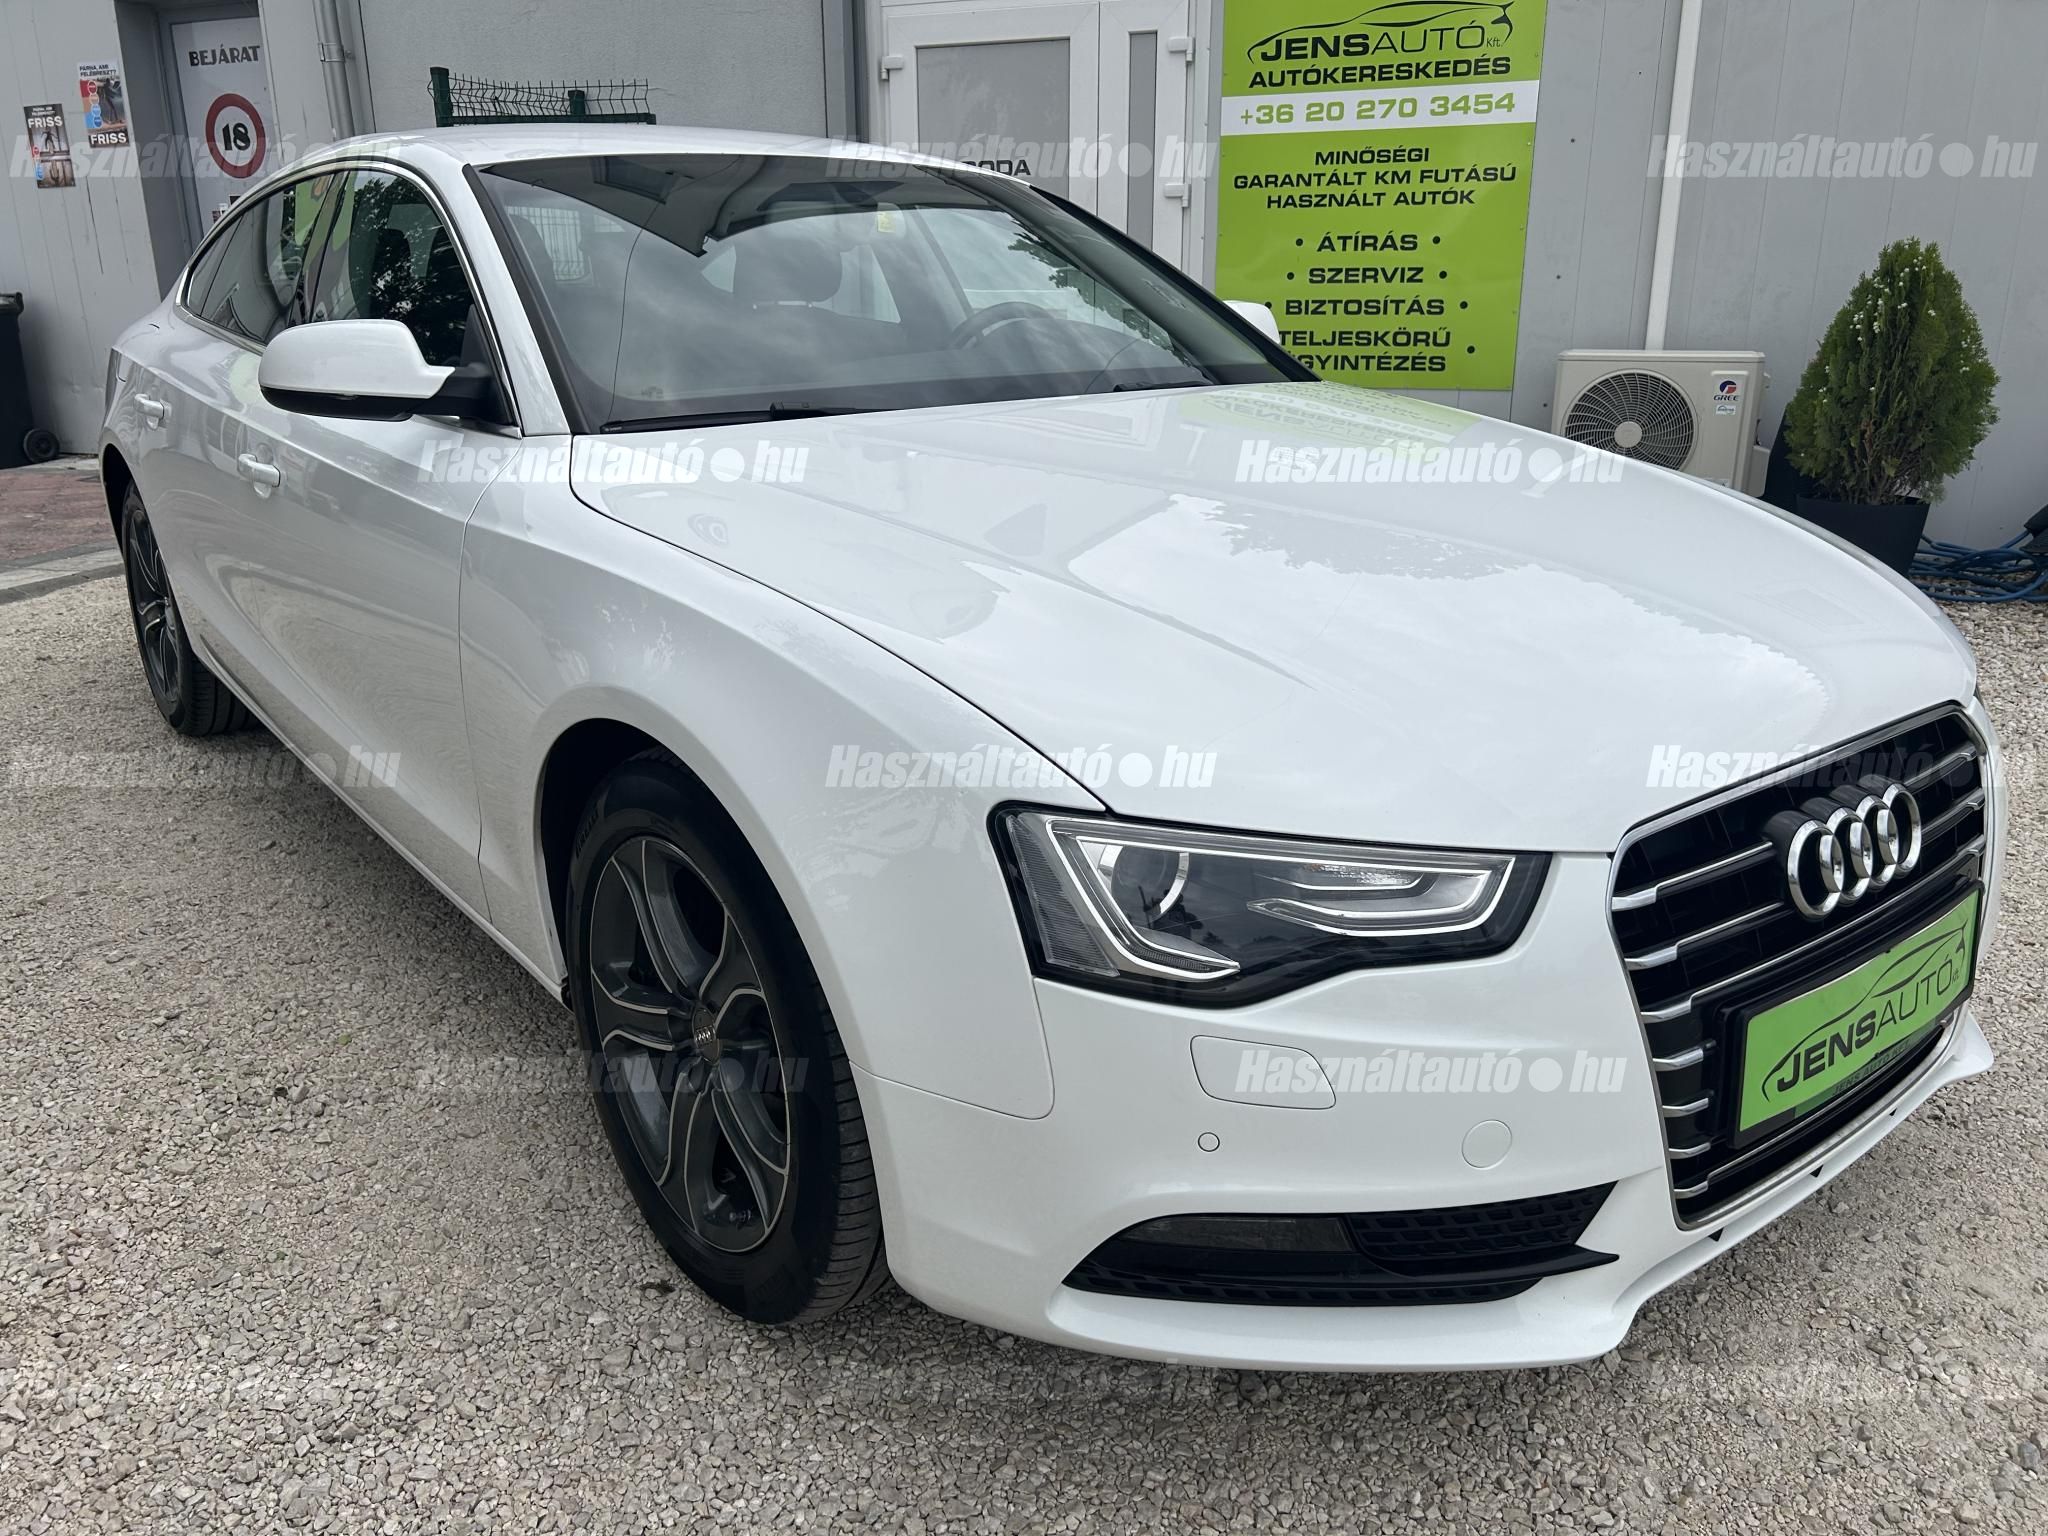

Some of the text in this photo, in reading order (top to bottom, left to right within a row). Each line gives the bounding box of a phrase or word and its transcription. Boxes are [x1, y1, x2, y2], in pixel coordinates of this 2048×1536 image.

[1261, 20, 1486, 62] JENSAUTÓ
[189, 45, 261, 67] BEJÁRAT
[1248, 53, 1512, 89] AUTÓKERESKEDÉS
[1240, 92, 1516, 125] +36 20 270 3454
[28, 115, 63, 129] FRISS
[90, 132, 127, 145] FRISS
[222, 122, 251, 152] 18
[1315, 145, 1430, 166] MINŐSÉGI
[962, 159, 1031, 176] ODA
[1233, 164, 1517, 189] GARANTÁLT KM FUTÁSÚ
[1266, 186, 1475, 209] HASZNÁLT AUTÓK
[1316, 230, 1418, 252] ÁTÍRÁS
[1308, 266, 1424, 284] SZERVIZ
[1285, 295, 1445, 316] BIZTOSÍTÁS
[1279, 326, 1451, 348] TELJESKÖRŰ
[1287, 350, 1446, 372] GYINTÉZÉS
[1713, 394, 1740, 402] GREE
[1777, 953, 1953, 1093] JENSAUTÓ
